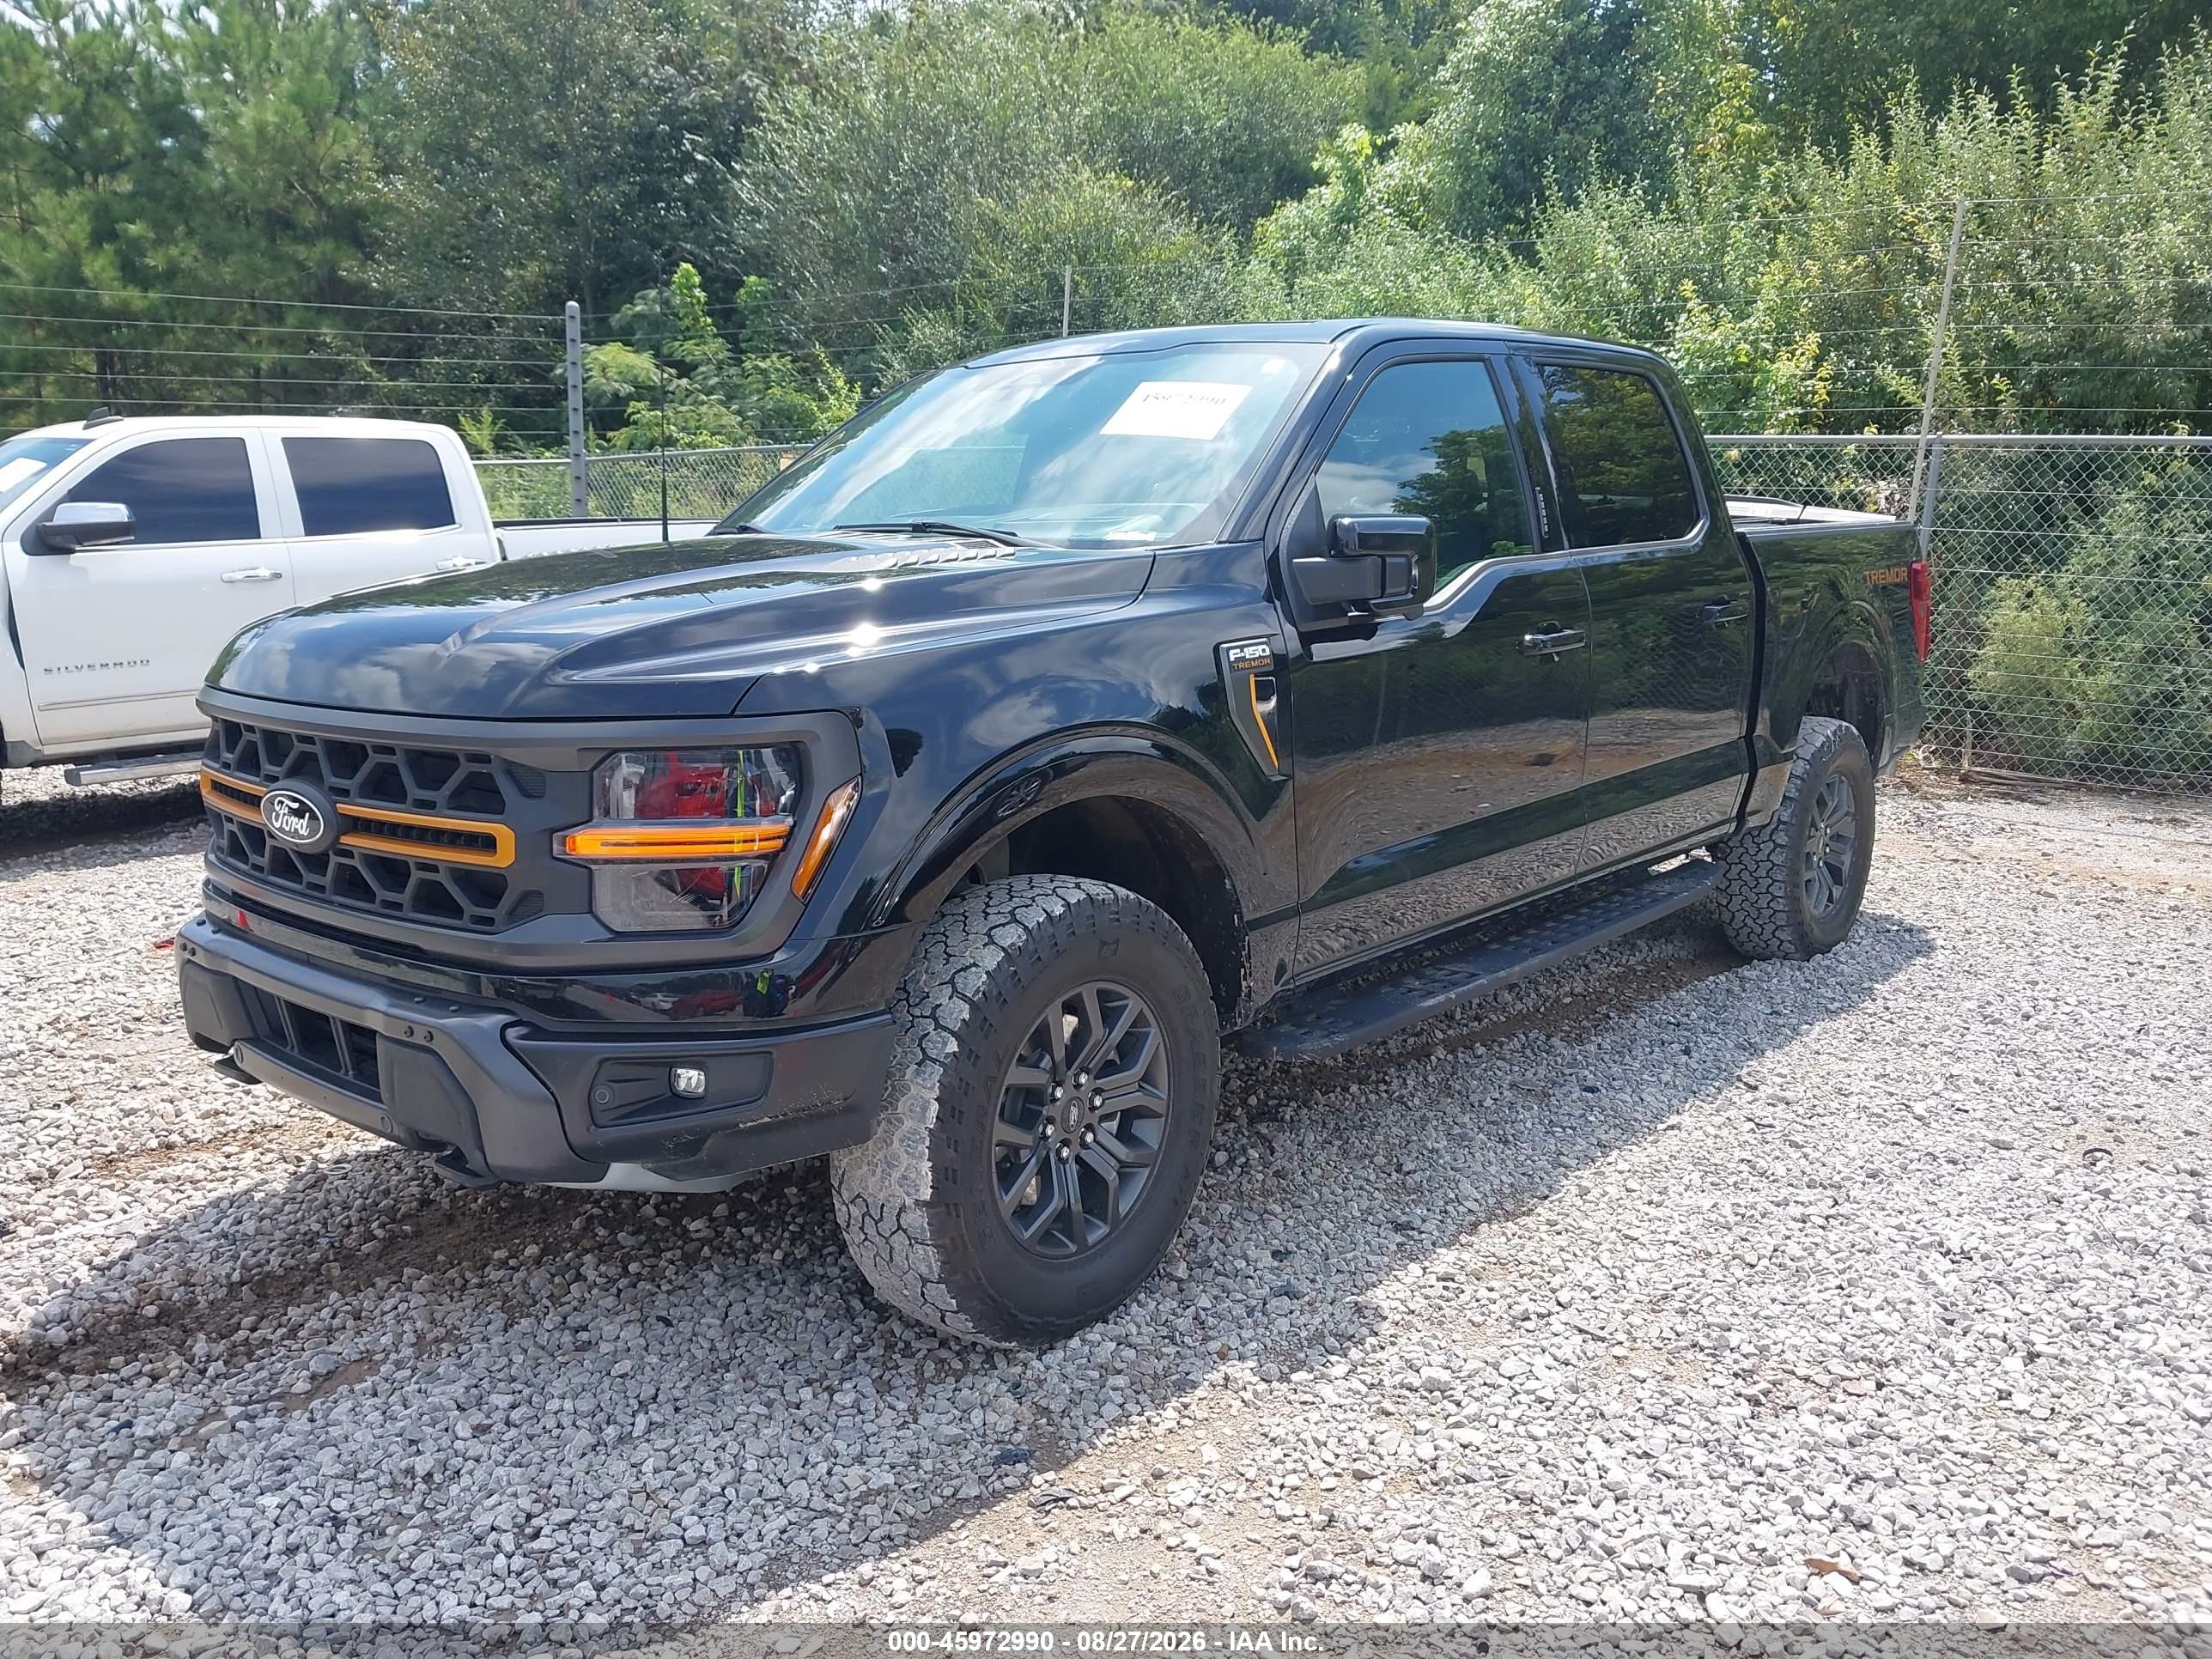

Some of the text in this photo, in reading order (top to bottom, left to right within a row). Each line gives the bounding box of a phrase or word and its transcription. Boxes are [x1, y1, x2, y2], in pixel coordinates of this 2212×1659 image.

[1863, 568, 1907, 584] TREMOR
[1229, 645, 1270, 661] F-150
[44, 659, 150, 675] SILVERADO
[1232, 659, 1271, 671] TREMOR
[272, 797, 309, 836] Ford
